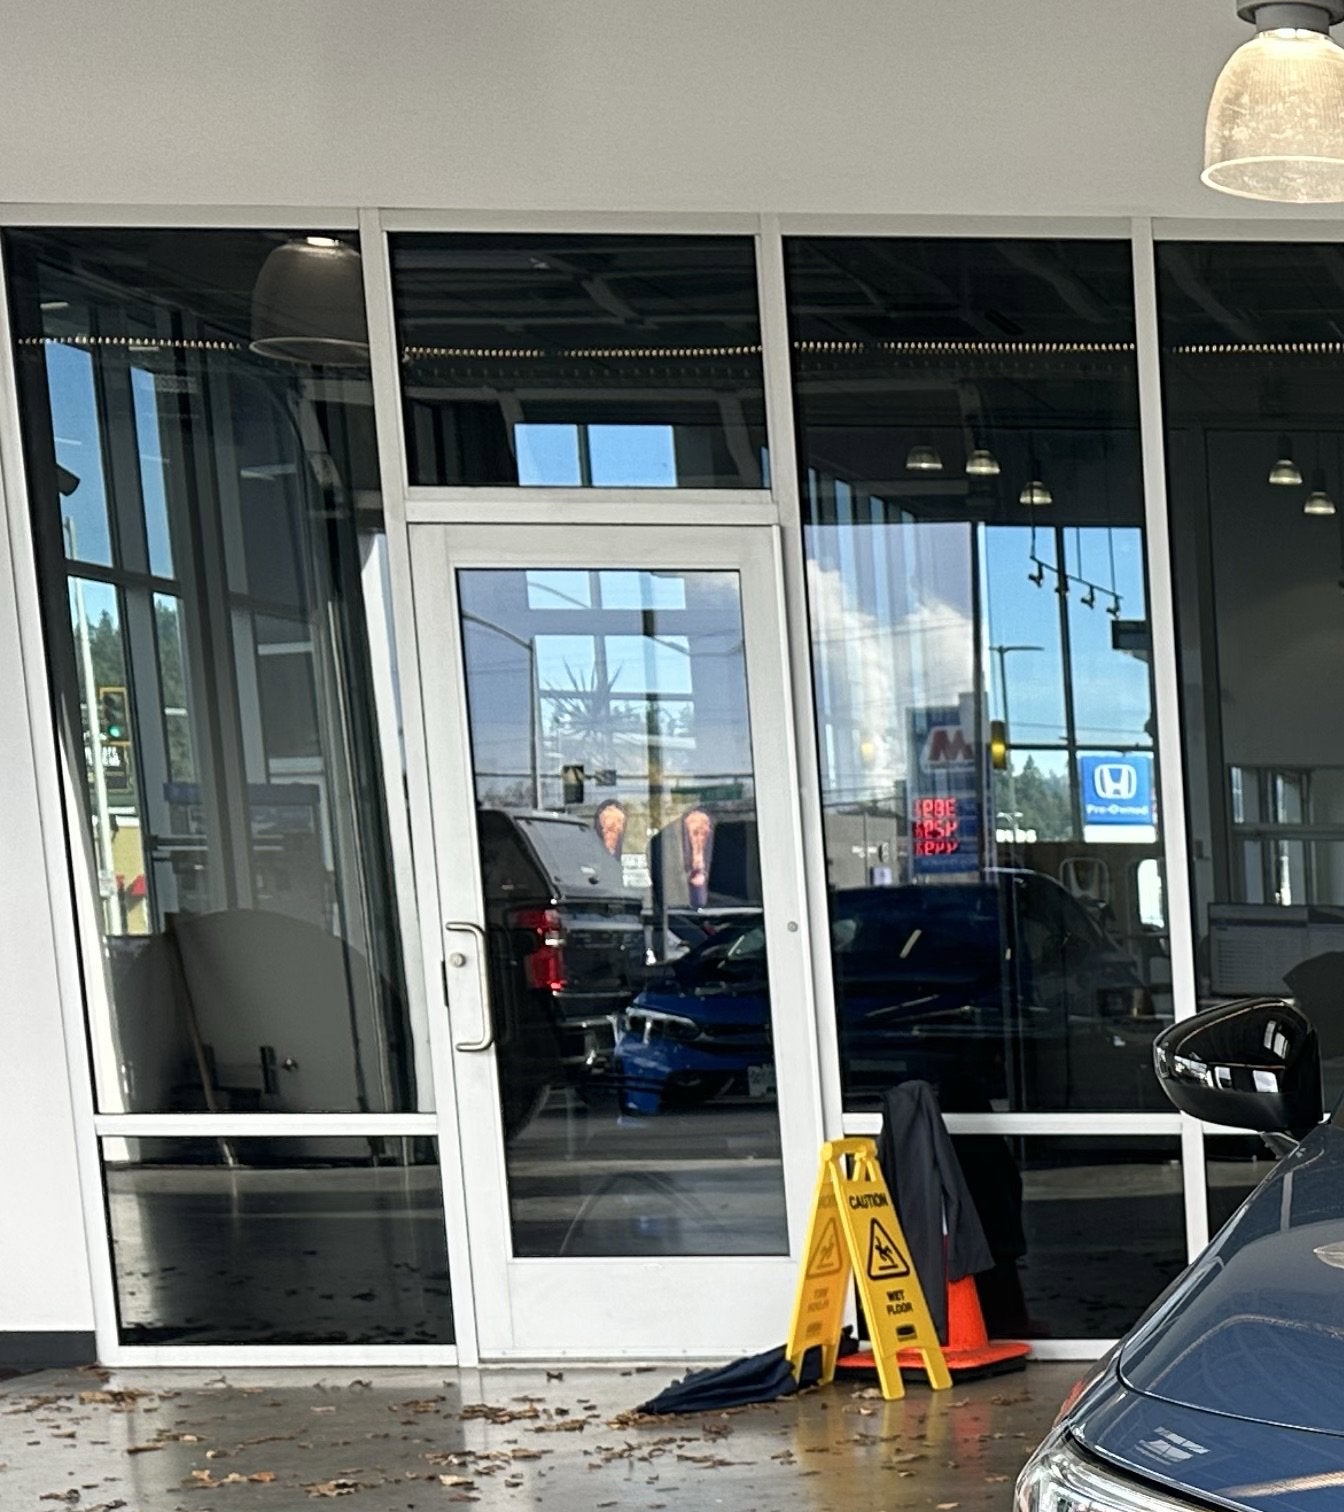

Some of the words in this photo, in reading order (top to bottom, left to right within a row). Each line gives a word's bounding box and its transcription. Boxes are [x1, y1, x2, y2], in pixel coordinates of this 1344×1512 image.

[849, 1193, 888, 1210] CAUTION
[887, 1290, 905, 1301] WET
[887, 1302, 913, 1315] FLOOR
